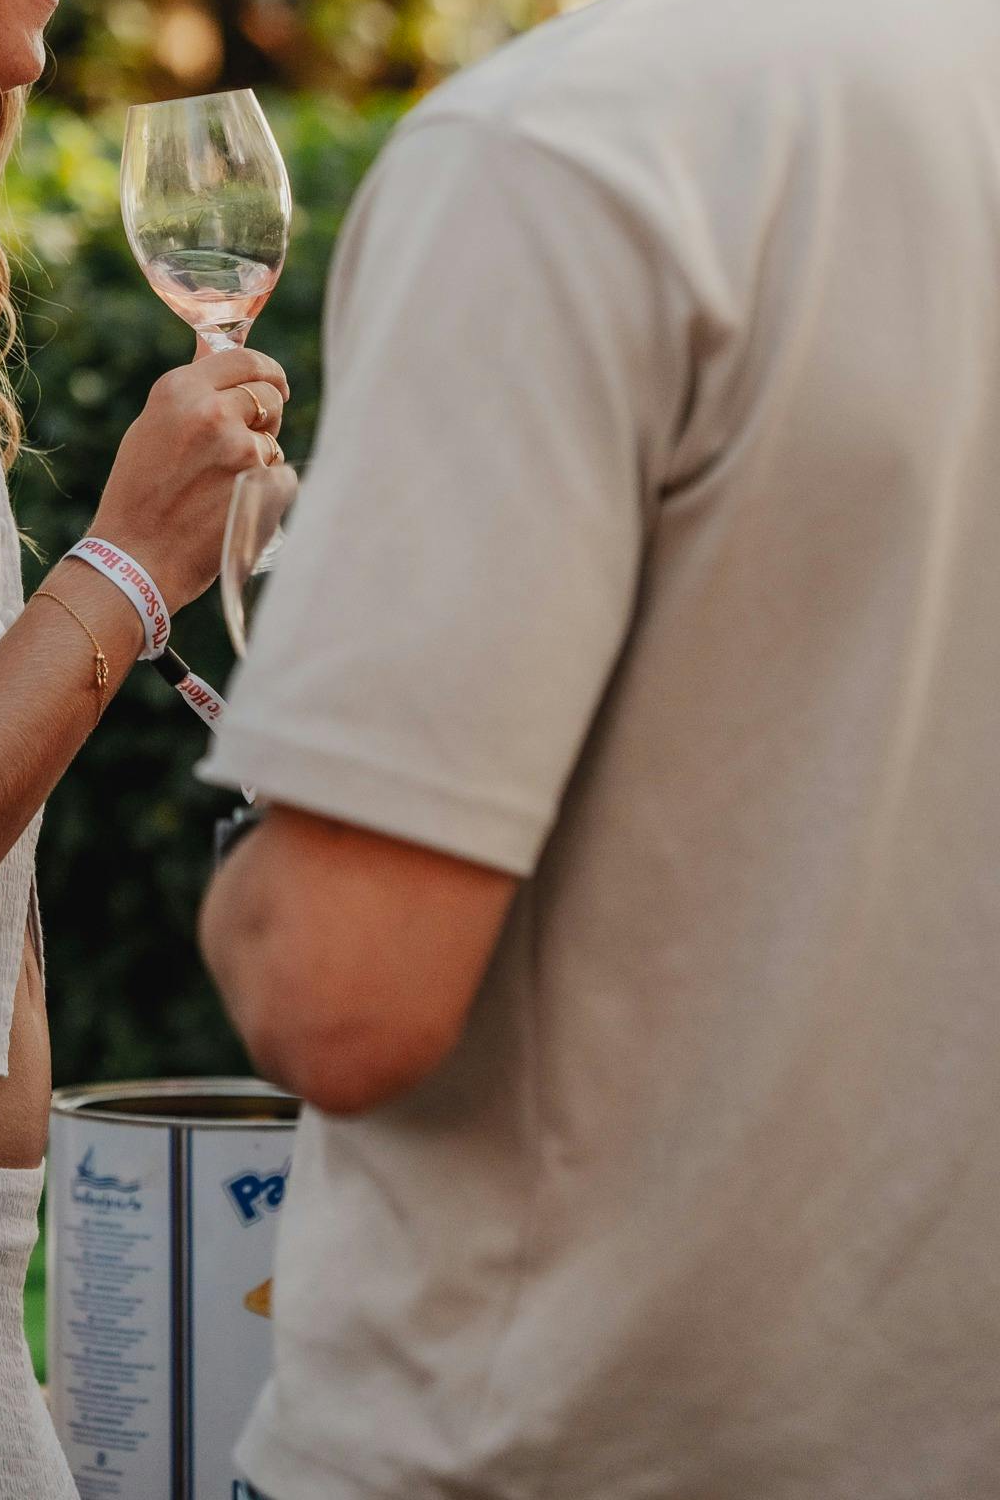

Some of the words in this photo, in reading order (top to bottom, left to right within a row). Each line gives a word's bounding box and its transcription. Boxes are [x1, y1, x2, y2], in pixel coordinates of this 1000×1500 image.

[78, 541, 121, 570] Hotel
[119, 564, 161, 617] Scenic
[151, 613, 168, 649] The
[176, 676, 210, 706] Hot
[229, 1173, 286, 1220] Pa
